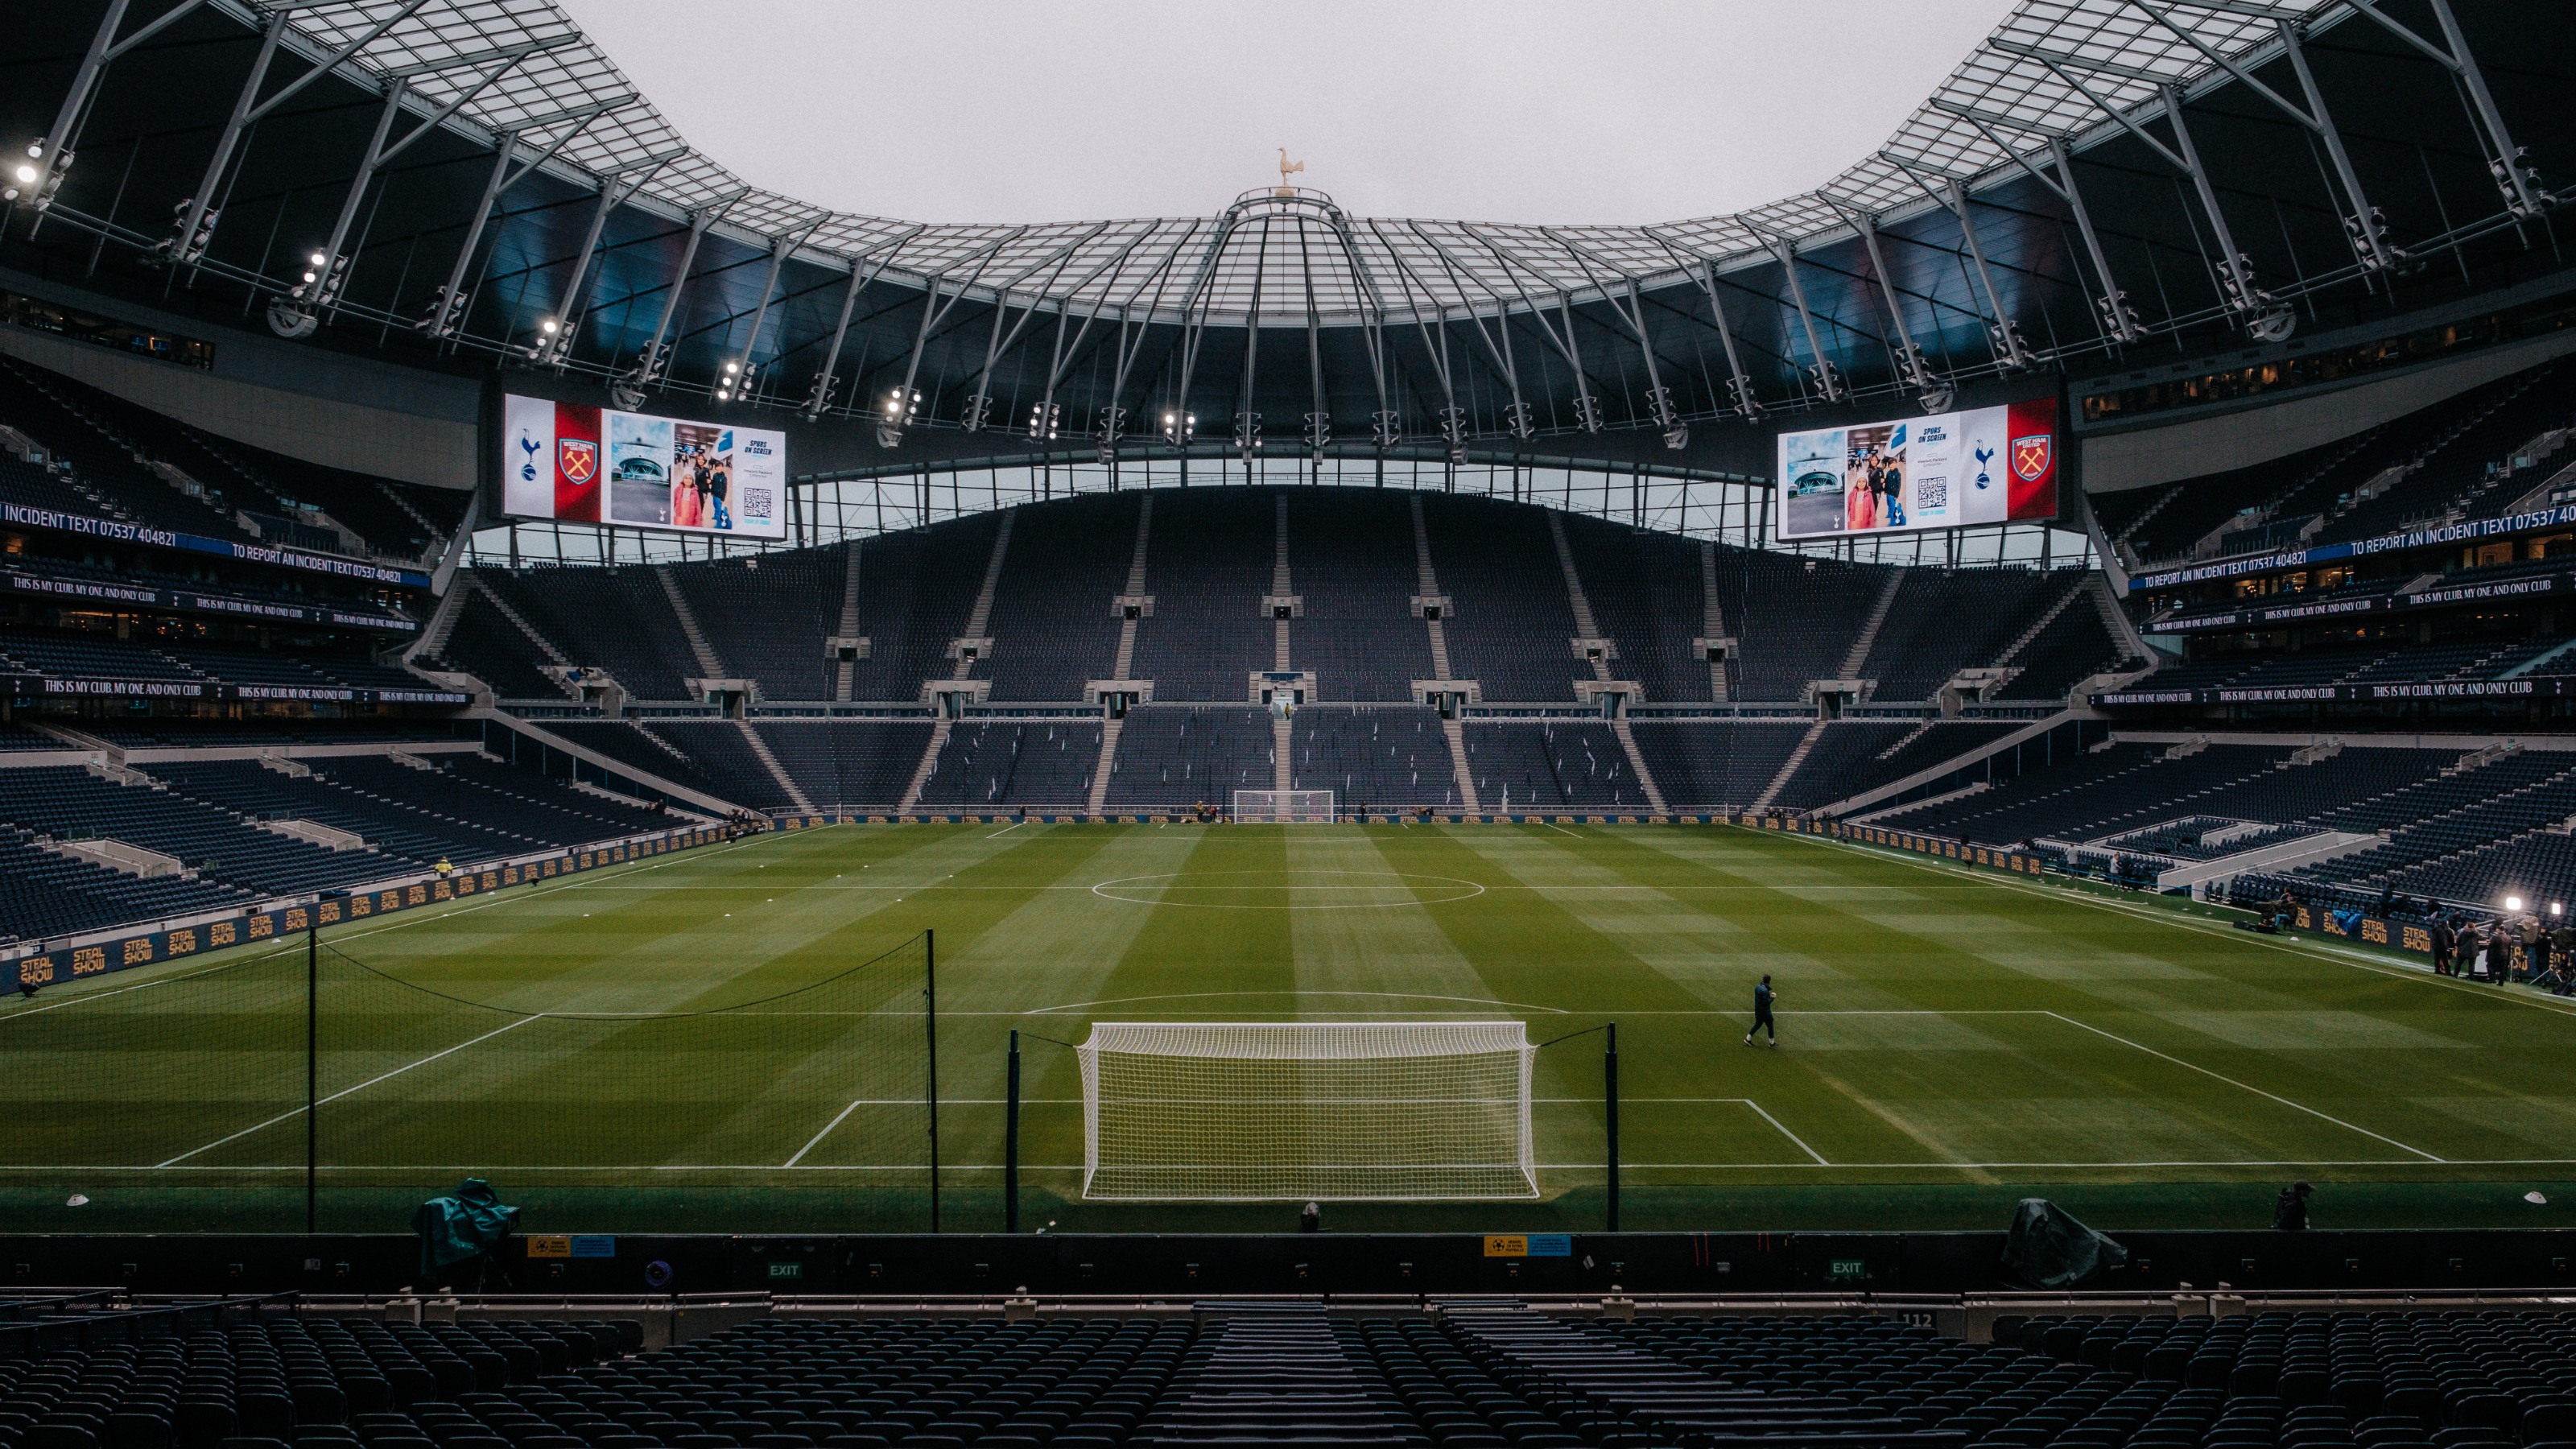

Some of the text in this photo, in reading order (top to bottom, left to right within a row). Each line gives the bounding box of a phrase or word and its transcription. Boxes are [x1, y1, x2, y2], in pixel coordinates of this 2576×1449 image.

[1924, 427, 1941, 435] SPURS
[1927, 434, 1946, 442] SCREEN
[5, 506, 175, 546] INCIDENT TEXT 07537 404821
[2351, 542, 2363, 555] TO
[2366, 535, 2405, 552] REPORT
[2408, 531, 2422, 546] AN
[2426, 522, 2478, 543] INCIDENT
[2480, 517, 2512, 534] TEXT
[2515, 510, 2554, 529] 07537
[233, 544, 399, 582] TO REPORT AN INCIDENT TEXT 07537 404821
[2145, 551, 2306, 587] TO REPORT AN INCIDENT TEXT 07537 404821
[2409, 594, 2424, 604] THIS
[2425, 593, 2431, 602] IS
[2432, 592, 2442, 601] MY
[2463, 588, 2475, 597] MY
[2476, 587, 2491, 597] ONE
[2492, 584, 2508, 595] AND
[2510, 583, 2529, 593] ONLY
[2530, 580, 2550, 591] CLUB
[43, 680, 64, 691] THIS
[65, 681, 74, 691] IS
[75, 681, 89, 692] MY
[114, 683, 126, 693] MY
[128, 683, 144, 694] ONE
[145, 684, 162, 694] AND
[163, 684, 182, 695] ONLY
[183, 685, 200, 696] CLUB
[2372, 687, 2389, 696] THIS
[2391, 686, 2397, 696] IS
[2399, 686, 2411, 696] MY
[2434, 685, 2446, 695] MY
[2447, 684, 2464, 695] ONE
[2466, 683, 2484, 694] AND
[2486, 683, 2508, 694] ONLY
[2509, 682, 2532, 693] CLUB
[351, 896, 371, 907] STEAL
[381, 891, 399, 902] STEAL
[320, 902, 340, 914] STEAL
[351, 903, 371, 917] SHOW
[381, 898, 399, 911] SHOW
[250, 914, 273, 927] STEAL
[287, 908, 308, 920] STEAL
[320, 910, 340, 923] SHOW
[211, 922, 236, 935] STEAL
[287, 917, 308, 931] SHOW
[2362, 919, 2387, 932] STEAL
[169, 930, 196, 943] STEAL
[250, 924, 272, 939] SHOW
[2362, 929, 2387, 943] SHOW
[2403, 927, 2430, 940] STEAL
[124, 939, 152, 952] STEAL
[211, 931, 235, 947] SHOW
[2403, 937, 2430, 952] SHOW
[73, 947, 105, 962] STEAL
[169, 939, 196, 956] SHOW
[124, 948, 152, 964] SHOW
[21, 956, 53, 972] STEAL
[73, 958, 105, 975] SHOW
[20, 968, 53, 984] SHOW
[770, 1265, 799, 1275] EXIT
[1833, 1262, 1861, 1273] EXIT
[1903, 1314, 1932, 1327] 112
